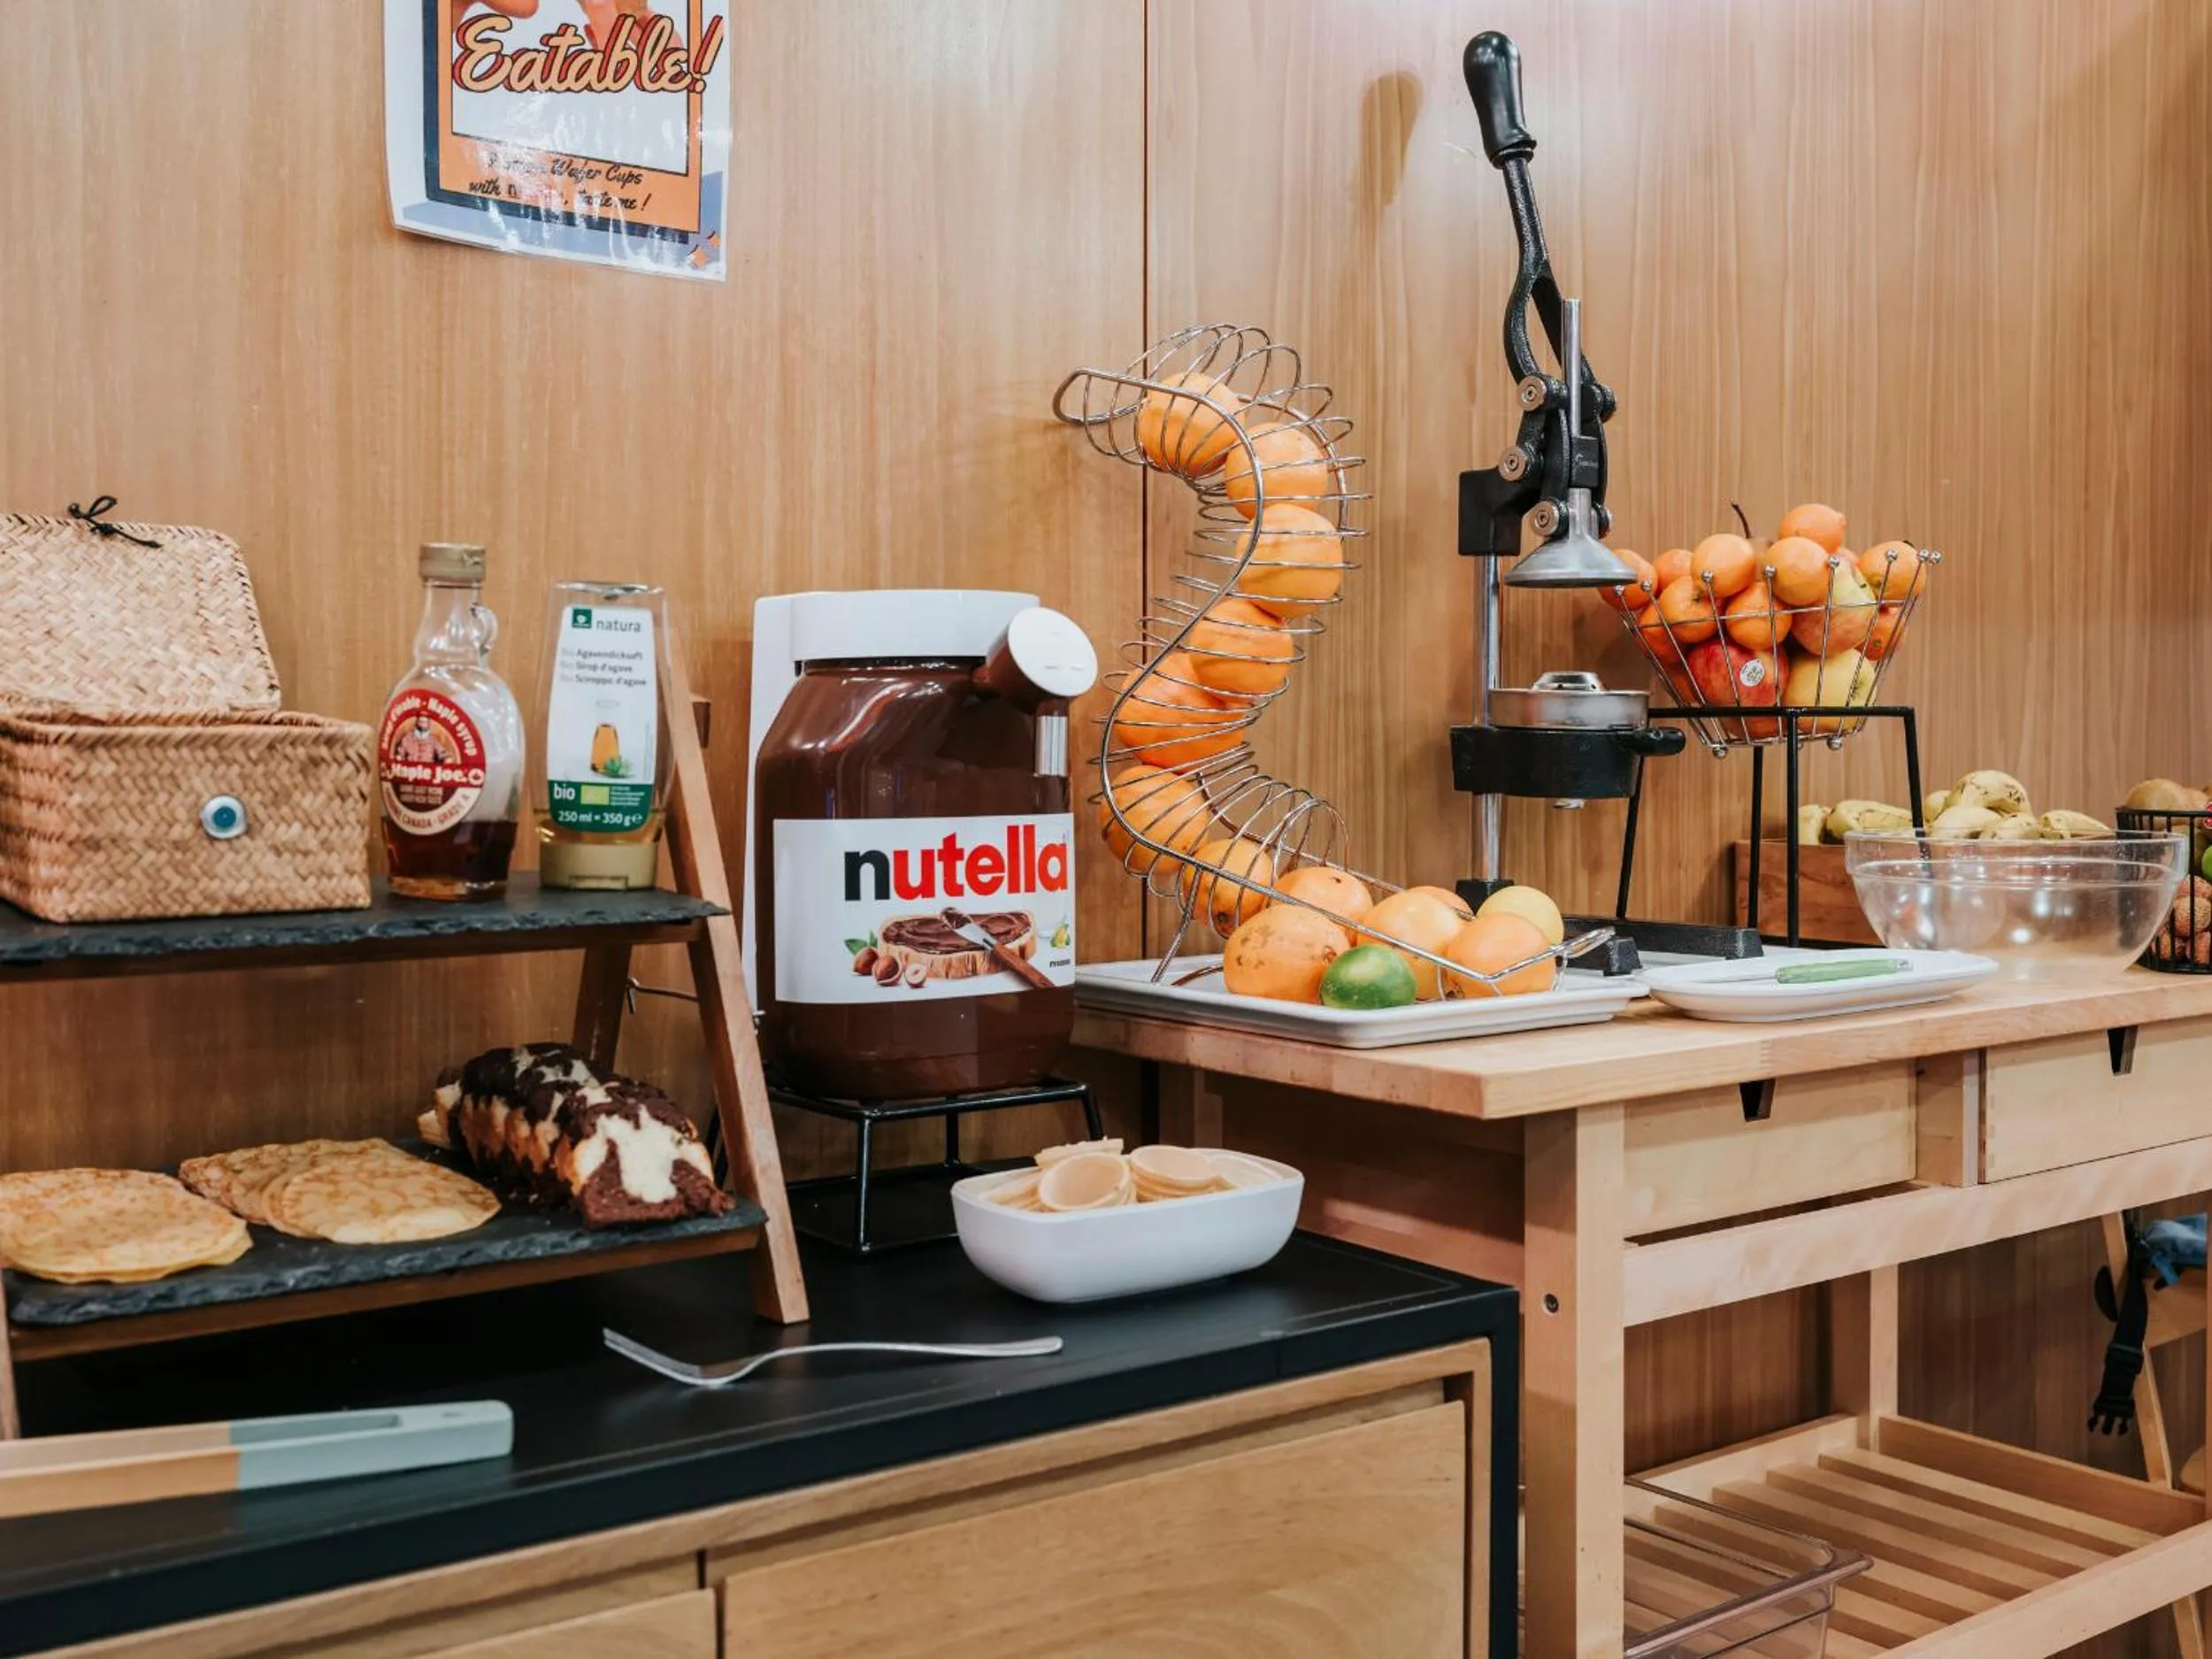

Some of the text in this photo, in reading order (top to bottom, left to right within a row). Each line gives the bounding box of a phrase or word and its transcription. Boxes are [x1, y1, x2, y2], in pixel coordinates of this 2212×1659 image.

[453, 12, 724, 93] Eatable!
[549, 157, 603, 183] Wafer
[605, 164, 644, 189] Cups
[468, 176, 501, 196] with
[579, 188, 612, 208] tate
[595, 619, 641, 633] natura
[553, 782, 576, 801] bio
[557, 810, 578, 823] 250
[579, 810, 593, 823] ml
[603, 811, 623, 825] 350
[844, 824, 1069, 902] nutella
